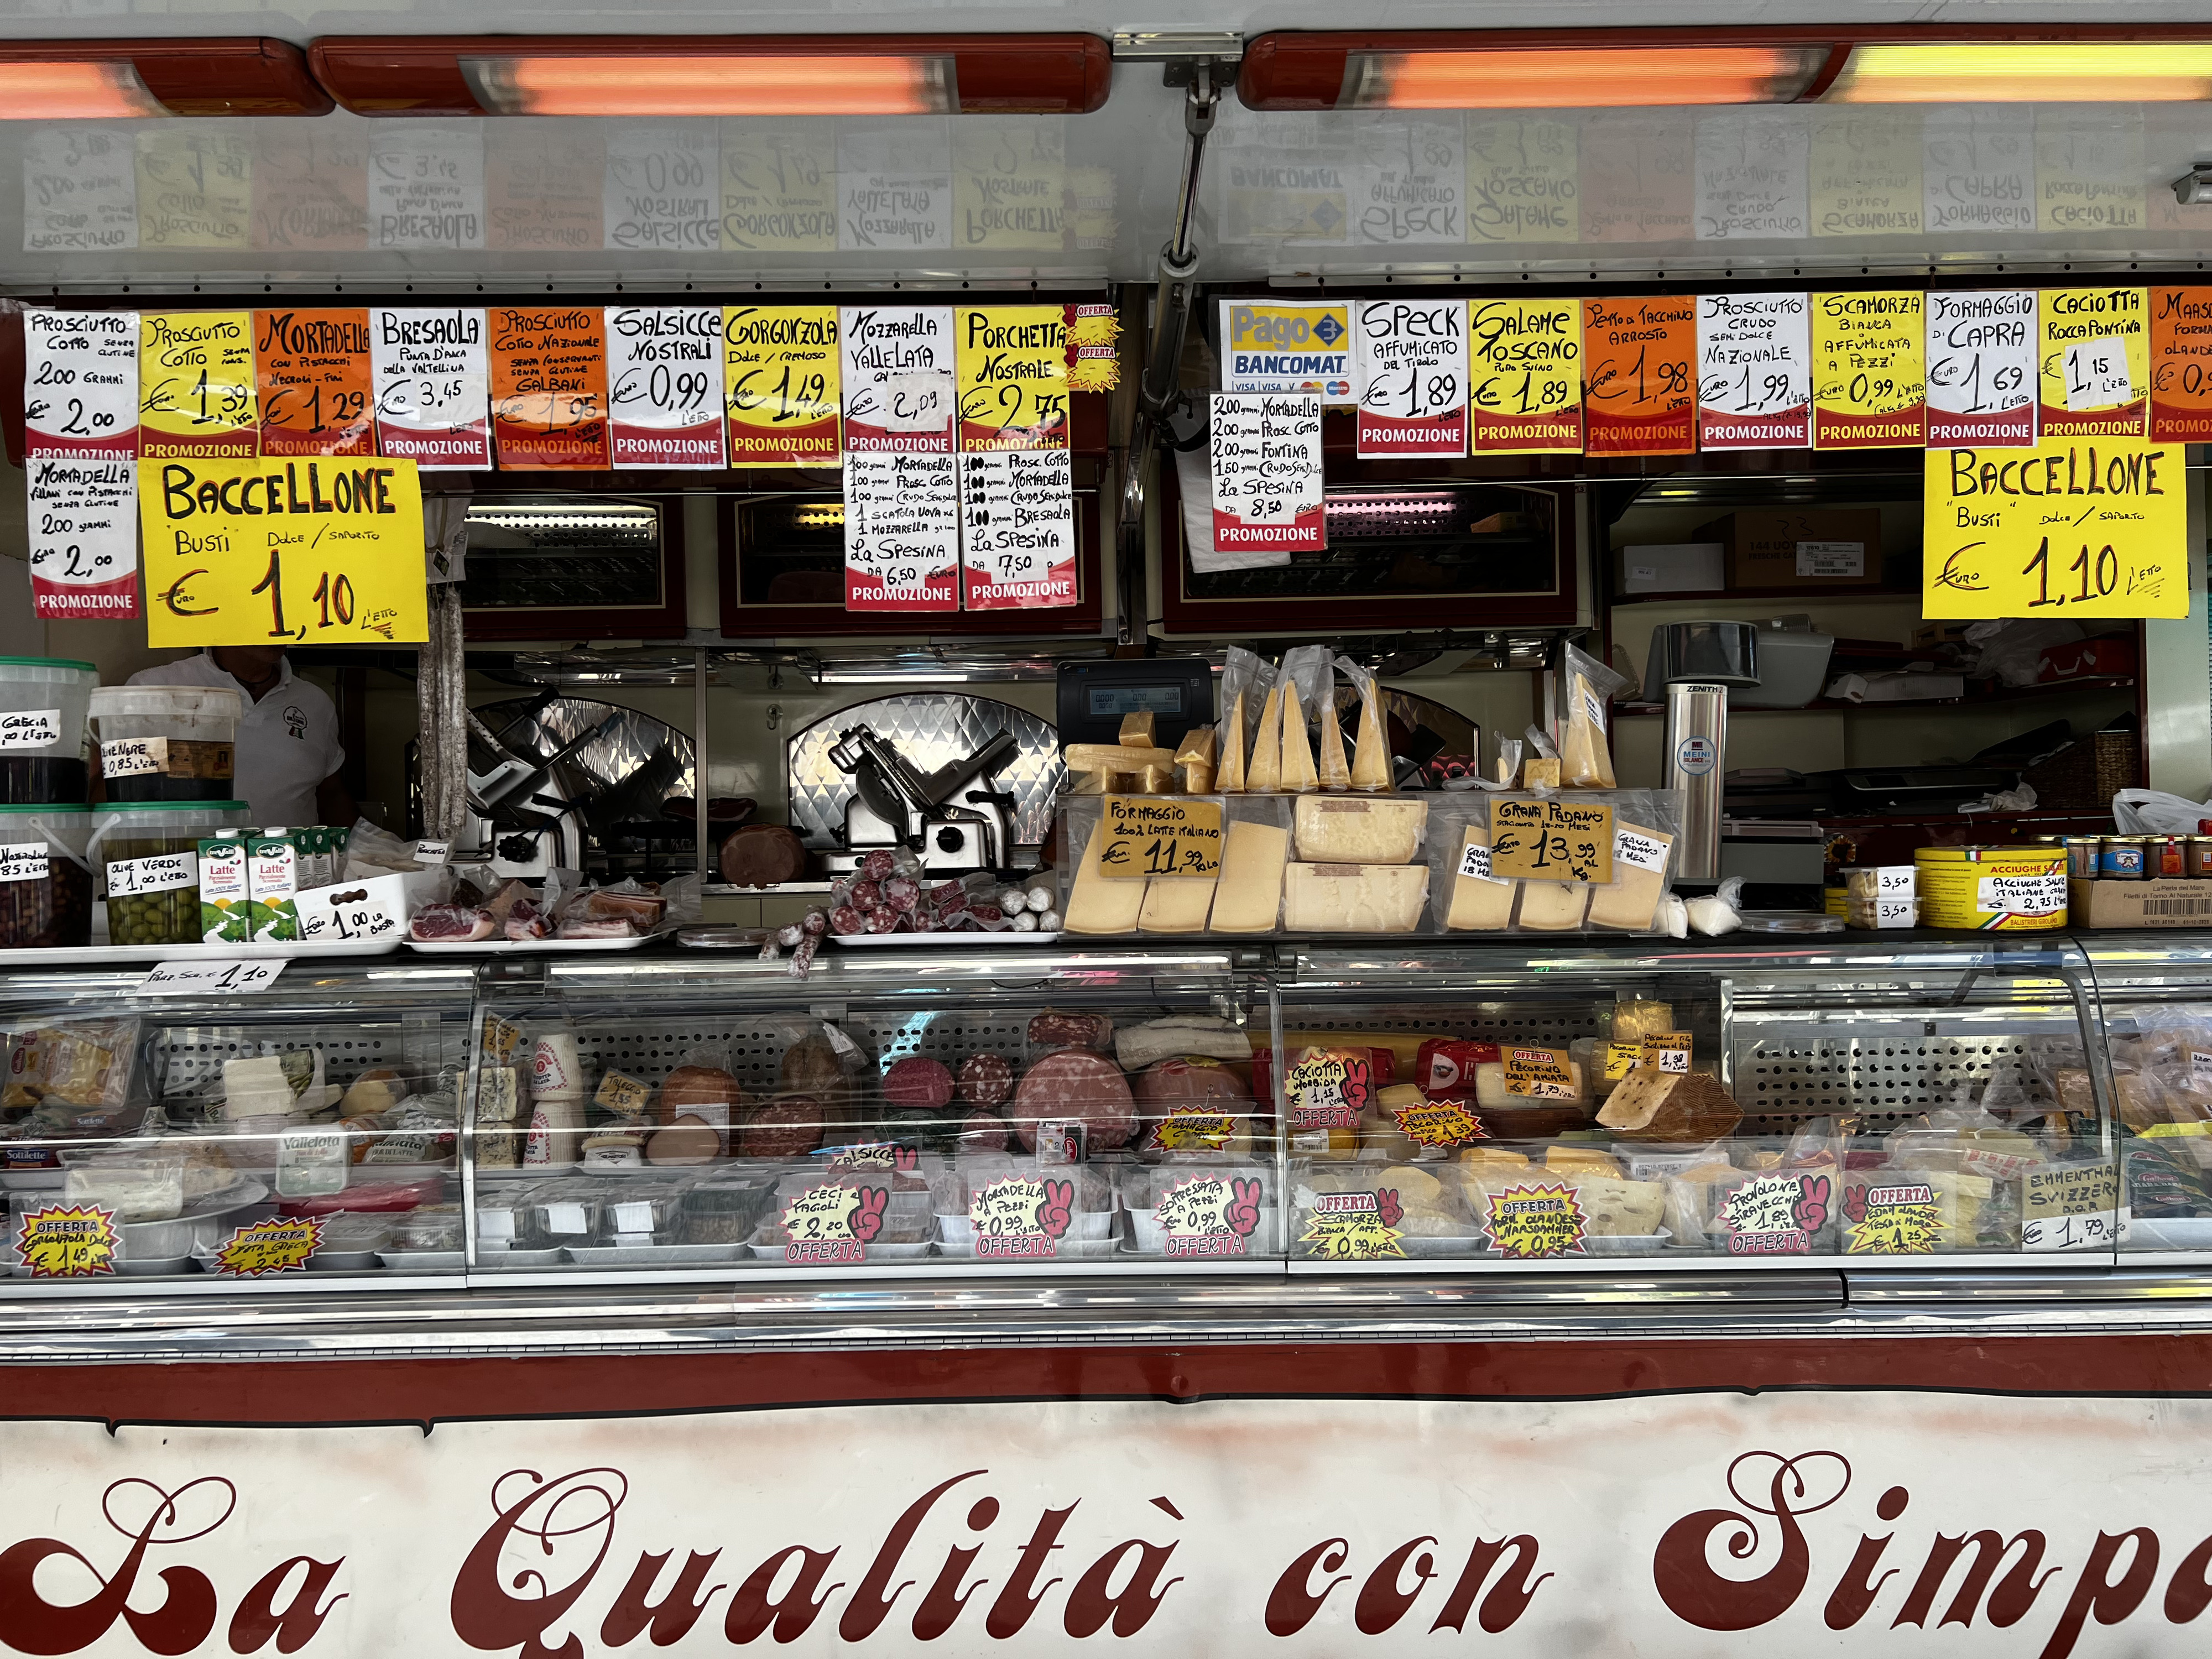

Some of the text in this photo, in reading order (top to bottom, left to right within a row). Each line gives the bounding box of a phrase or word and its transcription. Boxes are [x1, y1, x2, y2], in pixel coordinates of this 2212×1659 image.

[1078, 306, 1112, 315] OFFERTA
[1704, 296, 1802, 319] PROSCIUTTO
[1824, 295, 1920, 316] SCAMORZA
[1935, 293, 2032, 320] FORMAGGIO
[2053, 290, 2139, 314] CACIOTTA
[32, 315, 126, 332] PROSCIUTTO
[498, 310, 590, 333] PROSCIUTTO
[614, 310, 722, 337] SALSICCE
[1361, 304, 1459, 338] SPECK
[1473, 302, 1569, 340] SALAME
[1641, 305, 1693, 325] TACCHINO
[147, 318, 240, 347] PROSCIUTTO
[382, 310, 479, 345] BRESAOLA
[725, 308, 837, 346] GORGONZOLA
[849, 311, 937, 344] MOZZARELLA
[969, 312, 1067, 348] PORCHETTA
[1232, 307, 1309, 351] Pago
[1728, 319, 1776, 329] CRUDO
[1839, 319, 1891, 330] BIANCA
[47, 336, 89, 349] COTTO
[259, 314, 369, 355] MORTADELLA
[1609, 328, 1667, 345] ARROSTO
[1739, 331, 1772, 340] DOLCE
[1948, 320, 2025, 348] CAPRA
[495, 336, 533, 351] COTTO
[629, 338, 711, 362] NOSTRALI
[1374, 340, 1458, 359] AFFUMICATO
[1477, 336, 1578, 363] TOSCANO
[1824, 338, 1911, 352] AFFUMICATA
[161, 346, 207, 367] COTTO
[851, 342, 933, 370] VALLELATA
[1706, 345, 1791, 364] NAZIONALE
[34, 361, 75, 384] 200
[976, 353, 1053, 382] NOSTRALE
[1234, 356, 1347, 374] BANCOMAT
[1384, 359, 1400, 369] DEL
[2068, 349, 2109, 393] 1,15
[1629, 345, 1688, 404] 1,98
[1960, 353, 2022, 413] 1,69
[516, 378, 585, 392] GALBANI
[650, 364, 708, 411] 0,99
[1262, 383, 1282, 391] VISA
[1399, 368, 1456, 416] 1,89
[1512, 372, 1567, 414] 1,89
[1735, 364, 1788, 411] 1,99
[420, 380, 462, 408] 3,45
[894, 392, 938, 420] 2,09
[1214, 396, 1240, 415] 200
[60, 398, 114, 435] 2,00
[1212, 418, 1319, 437] 200 COTTO
[1362, 429, 1459, 442] PROMOZIONE
[1478, 425, 1577, 440] PROMOZIONE
[1590, 426, 1687, 440] PROMOZIONE
[1705, 426, 1803, 439] PROMOZIONE
[1820, 425, 1921, 439] PROMOZIONE
[1930, 424, 2029, 438] PROMOZIONE
[2045, 420, 2140, 435] PROMOZIONE
[144, 444, 252, 457] PROMOZIONE
[265, 441, 367, 455] PROMOZIONE
[385, 440, 483, 455] PROMOZIONE
[502, 440, 602, 455] PROMOZIONE
[617, 439, 718, 454] PROMOZIONE
[735, 438, 833, 451] PROMOZIONE
[849, 437, 948, 451] PROMOZIONE
[1212, 438, 1308, 460] 200 FONTINA
[33, 447, 134, 460] PROMOZIONE
[1044, 452, 1069, 466] COTTO
[35, 464, 130, 486] MORTADELLA
[1213, 459, 1239, 477] 150
[1950, 447, 2164, 496] BACCELLONE
[163, 463, 396, 519] BACCELLONE
[1015, 504, 1070, 527] BRESAOLA
[1251, 499, 1282, 519] 8,50
[2039, 511, 2070, 524] DOLCE
[42, 513, 72, 535] 200
[872, 523, 928, 535] MOZZARELLA
[267, 531, 304, 547] DOLCE
[1220, 527, 1317, 541] PROMOZIONE
[64, 545, 112, 577] 2,00
[998, 555, 1031, 578] 7,50
[887, 567, 916, 586] 6,50
[2022, 536, 2117, 607] 1,10
[251, 549, 354, 640] 1,10
[853, 587, 951, 601] PROMOZIONE
[972, 582, 1070, 598] PROMOZIONE
[40, 594, 132, 609] PROMOZIONE
[1111, 802, 1185, 821] FORMAGGIO
[1499, 802, 1603, 822] GRANA PADANO
[1147, 825, 1219, 839] LATTE ITALIANO
[1144, 838, 1203, 874] 11,99
[1530, 829, 1595, 868] 13,99
[112, 859, 181, 873] OLIVE VERDE
[211, 865, 235, 875] Latte
[260, 864, 285, 875] Latte
[1584, 859, 1598, 867] AL
[1990, 865, 2042, 873] ACCIUGHE
[1882, 877, 1908, 890] 3,50
[1992, 878, 2042, 888] ACCIUGHE
[1995, 888, 2044, 897] ITALIANE
[1882, 905, 1907, 919] 3,50
[2023, 898, 2051, 910] 2,75
[332, 911, 368, 940] 1,00
[1516, 1052, 1551, 1061] OFFERTA
[1292, 1062, 1341, 1079] CACIOTTA
[1510, 1062, 1561, 1073] PECORINO
[1293, 1078, 1336, 1091] MORBIDA
[1534, 1082, 1559, 1095] 1,79
[1174, 1118, 1223, 1126] OFFERTA
[1293, 1109, 1357, 1126] OFFERTA
[1407, 1110, 1458, 1121] OFFERTA
[284, 1137, 341, 1150] Vallelata
[6, 1149, 46, 1160] Sottilette
[809, 1188, 843, 1200] CECI
[1869, 1187, 1930, 1204] OFFERTA
[794, 1201, 838, 1214] FAGIOLI
[1317, 1196, 1375, 1212] OFFERTA
[1503, 1201, 1566, 1213] OFFERTA
[36, 1221, 99, 1233] OFFERTA
[244, 1229, 307, 1243] OFFERTA
[1732, 1234, 1808, 1250] OFFERTA
[788, 1243, 863, 1260] OFFERTA
[980, 1238, 1055, 1255] OFFERTA
[1167, 1237, 1243, 1255] OFFERTA
[0, 1475, 349, 1655] La
[450, 1466, 1185, 1659] Qualità
[1265, 1532, 1555, 1637] con
